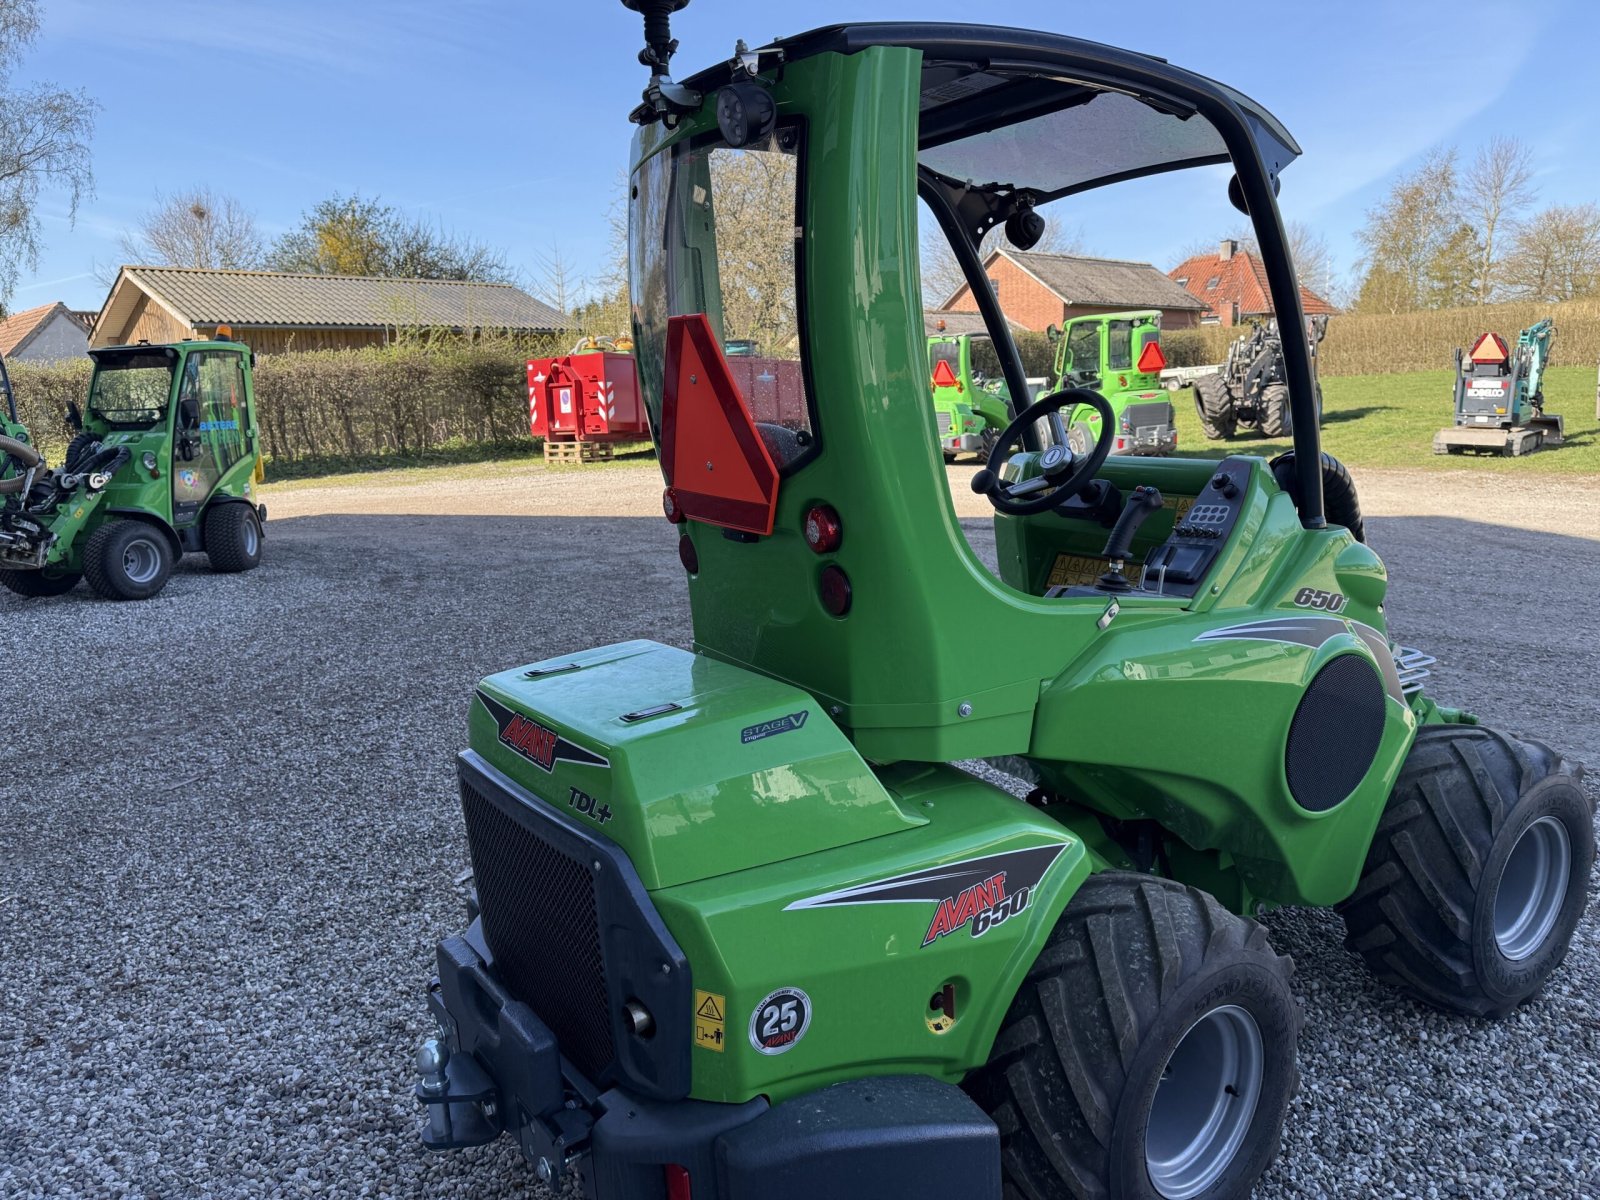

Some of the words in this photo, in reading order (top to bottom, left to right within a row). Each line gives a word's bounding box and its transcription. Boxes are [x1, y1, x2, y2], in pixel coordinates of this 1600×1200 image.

[500, 712, 559, 768] AVANT
[743, 718, 790, 737] STAGE
[789, 712, 807, 728] V
[568, 786, 612, 824] TDL+
[922, 871, 1007, 948] AVANT
[763, 1000, 797, 1038] 25
[763, 1031, 797, 1049] AVANT
